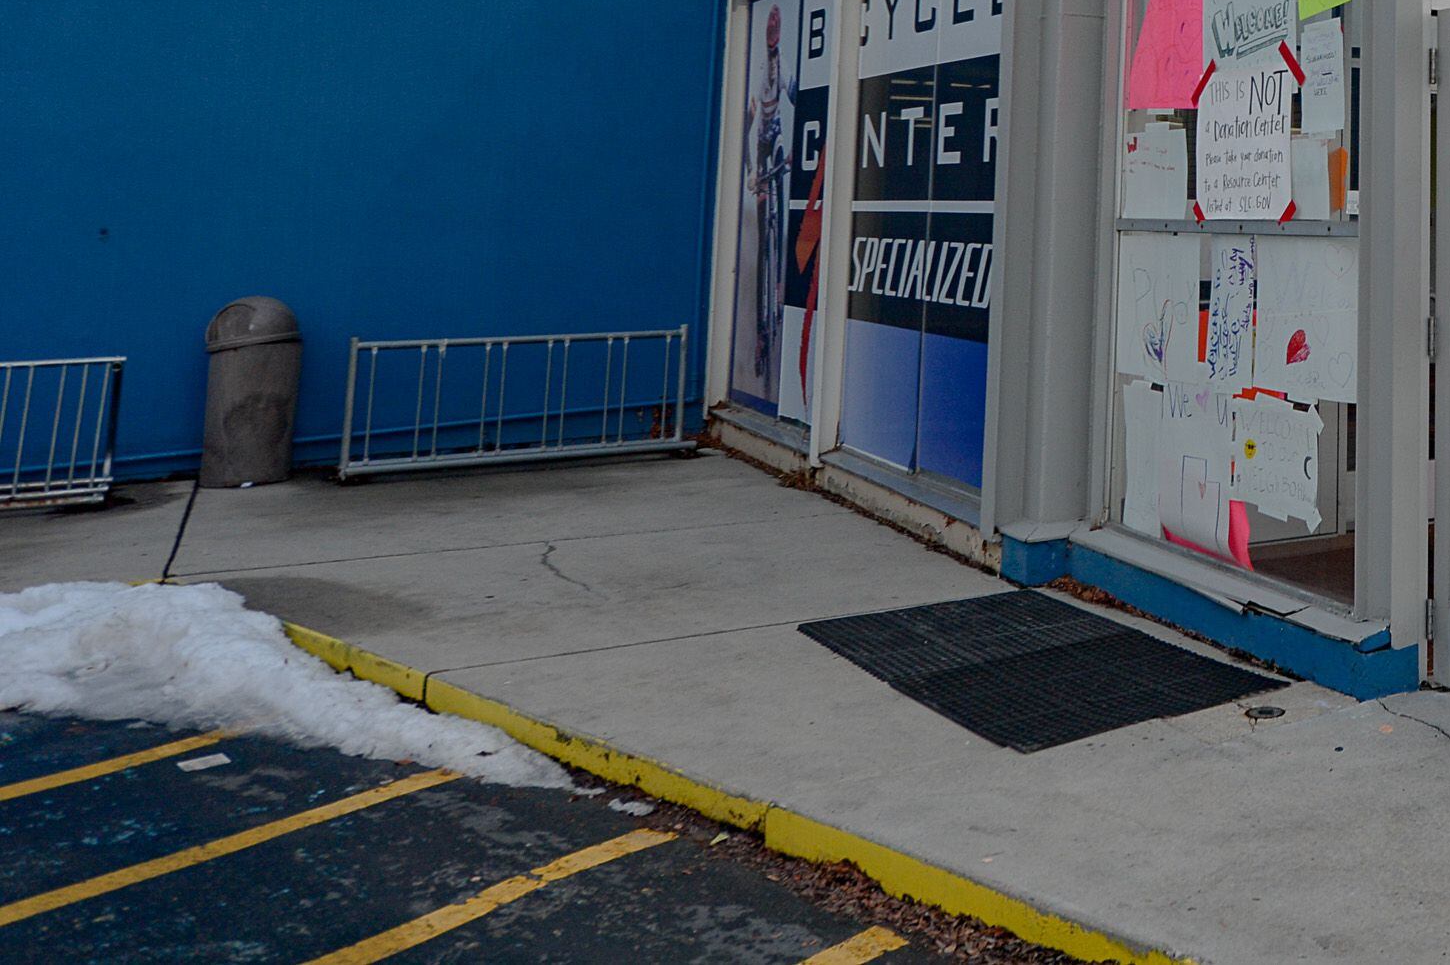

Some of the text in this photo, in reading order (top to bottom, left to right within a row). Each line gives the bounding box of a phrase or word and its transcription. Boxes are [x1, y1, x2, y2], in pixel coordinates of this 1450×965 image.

[1210, 80, 1230, 105] THIS
[1236, 81, 1245, 101] IS
[1249, 70, 1288, 115] NOT
[1214, 116, 1250, 142] Donation
[1254, 115, 1288, 136] Center
[1254, 148, 1283, 163] donation
[1252, 172, 1281, 189] Center
[847, 236, 994, 309] SPECIALIZED
